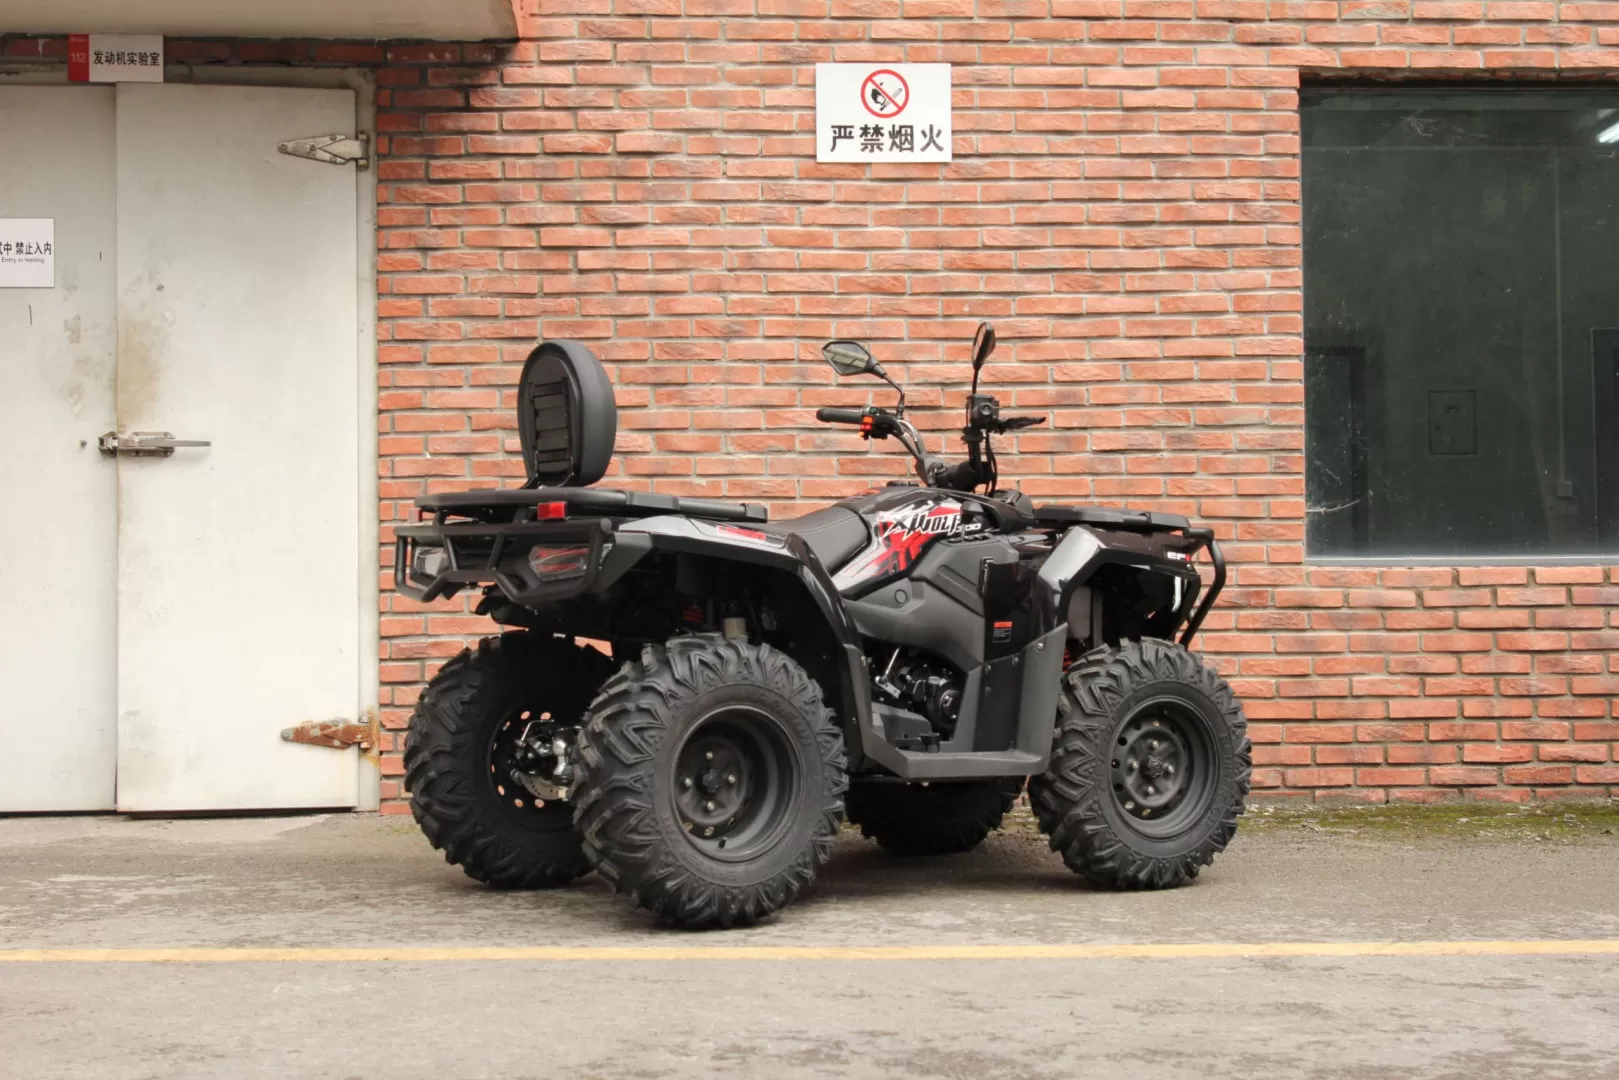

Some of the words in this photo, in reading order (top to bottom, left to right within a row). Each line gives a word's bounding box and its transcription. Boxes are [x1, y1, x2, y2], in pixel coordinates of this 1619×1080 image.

[70, 52, 86, 63] 112
[93, 50, 160, 66] 发动机实验室
[830, 124, 944, 152] 严禁烟火
[16, 241, 52, 255] 禁止入内
